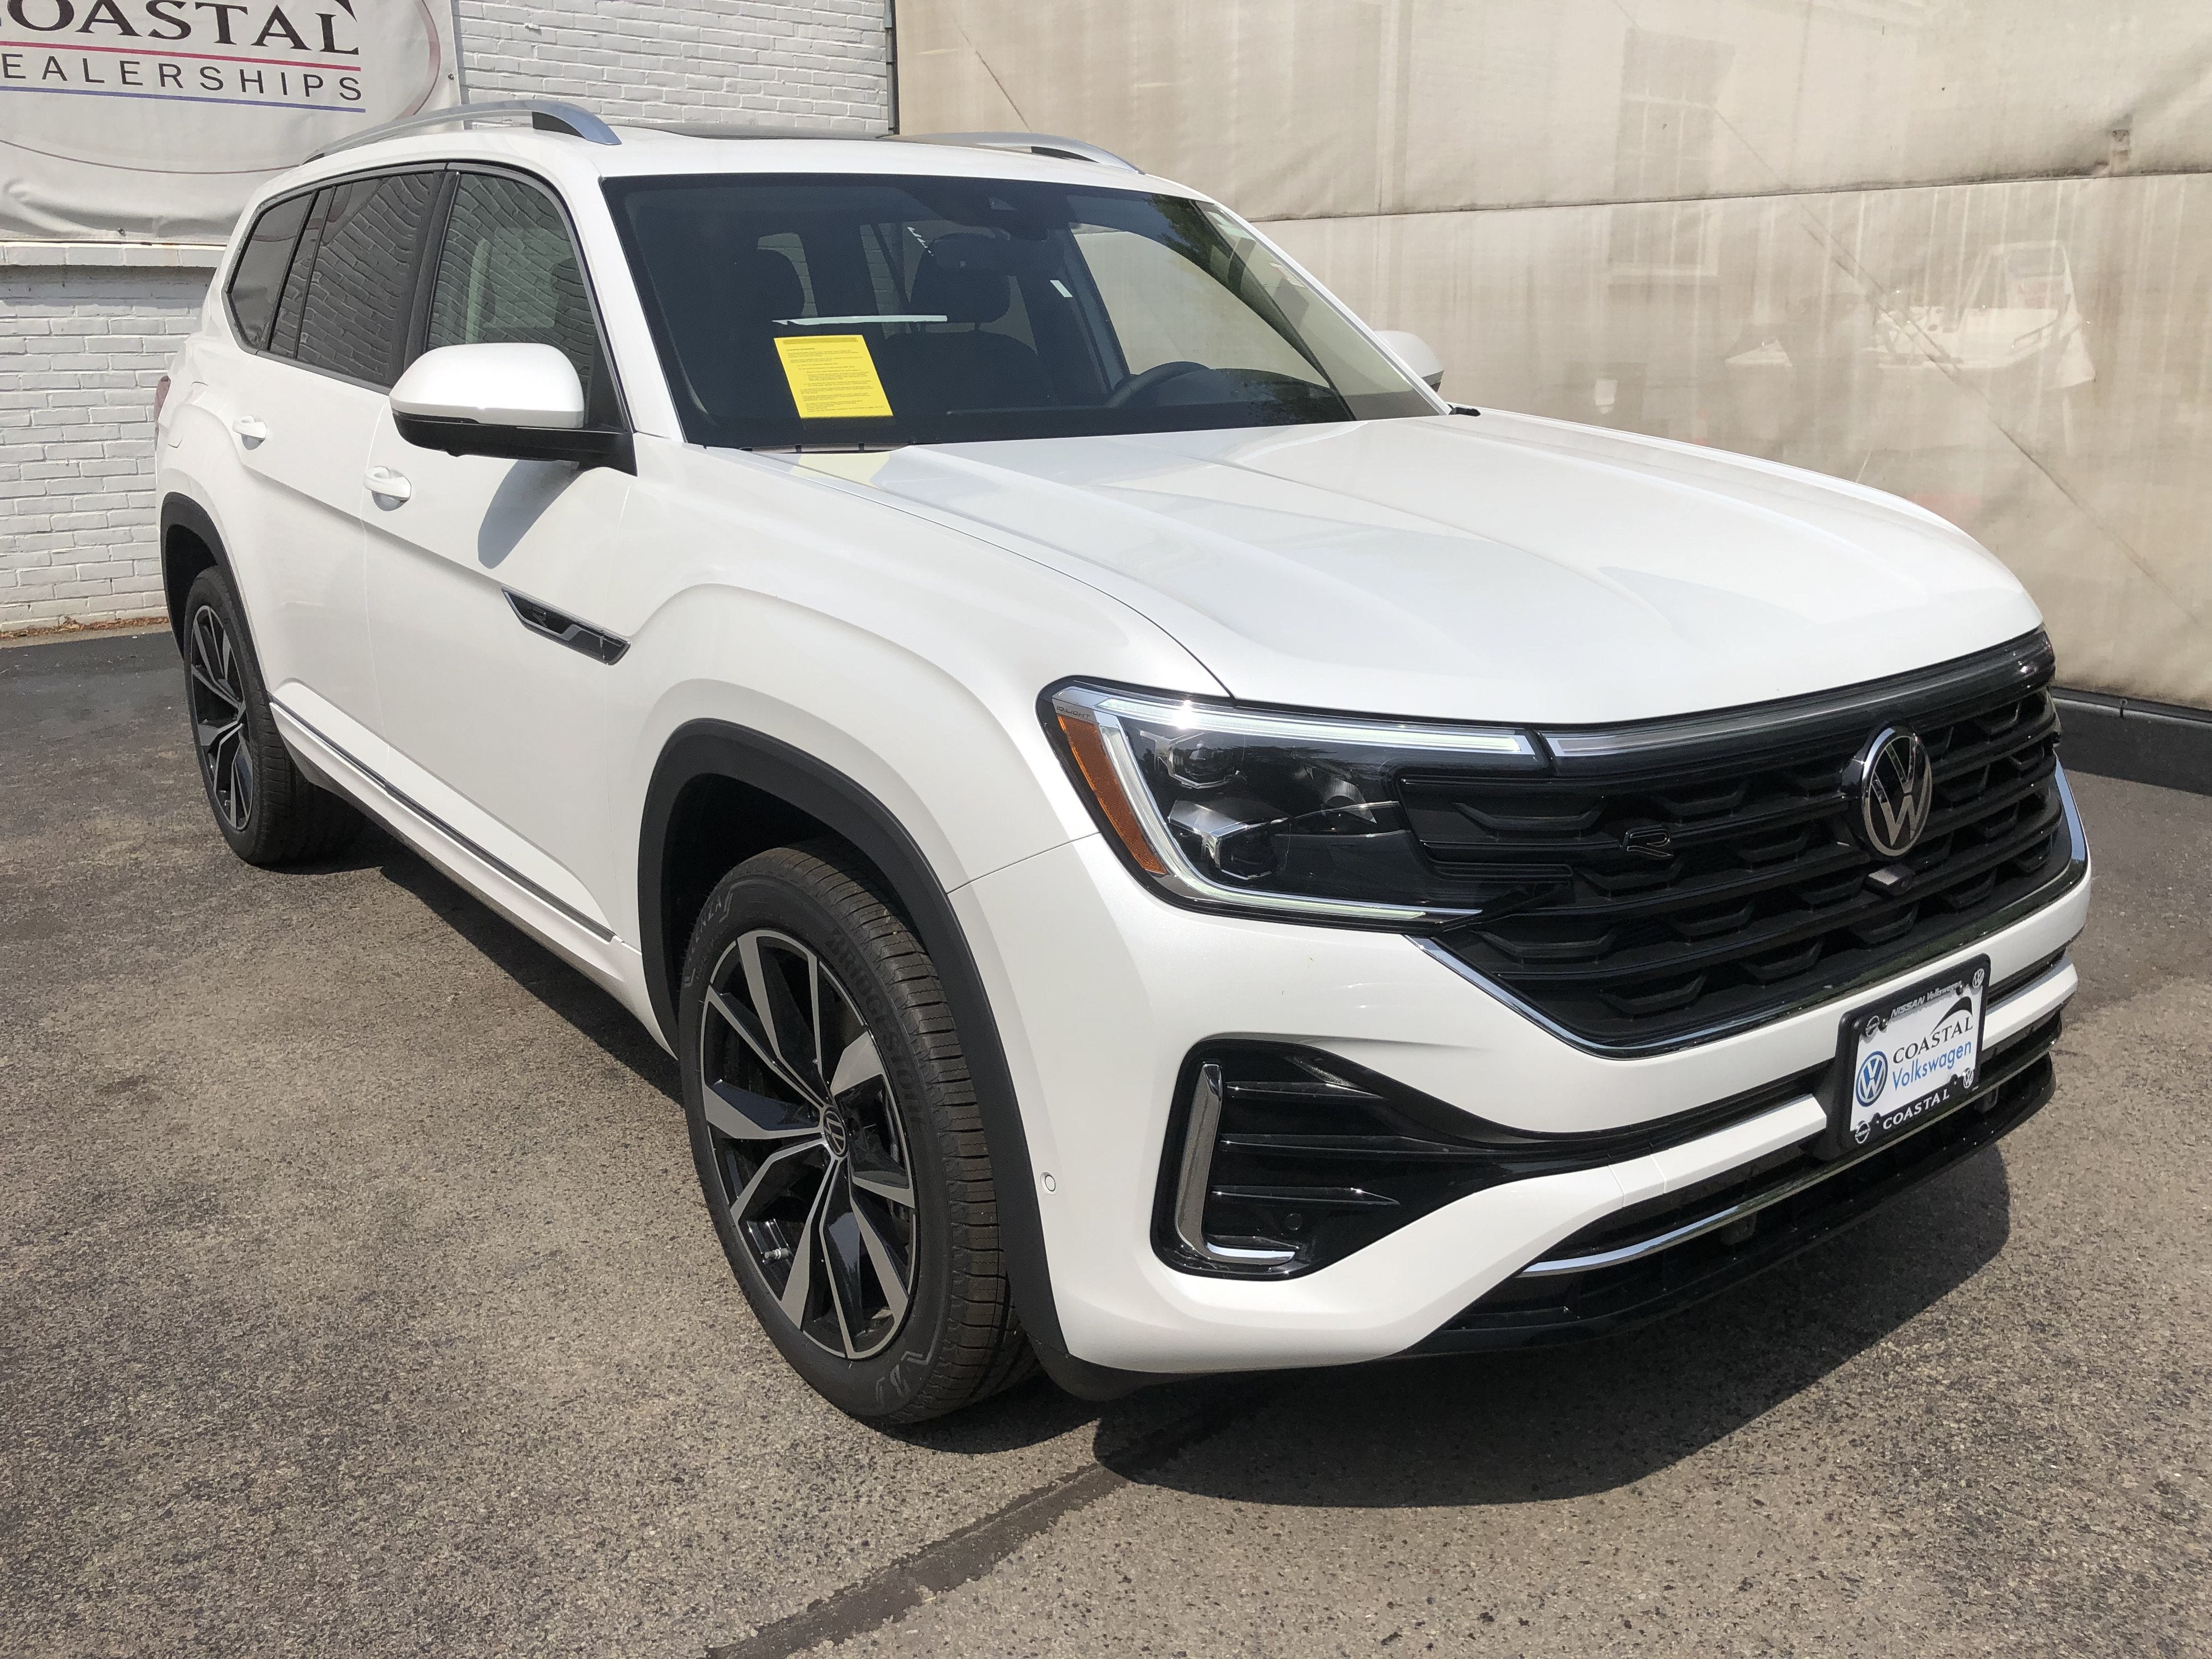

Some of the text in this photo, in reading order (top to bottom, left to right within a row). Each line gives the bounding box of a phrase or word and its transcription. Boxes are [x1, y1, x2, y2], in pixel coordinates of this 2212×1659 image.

[0, 0, 359, 55] OASTAL
[1, 53, 362, 100] EALERSHIPS
[1891, 995, 1925, 1018] NISSAN
[1893, 1017, 1973, 1064] COASTAL
[1892, 1041, 1972, 1091] Volkswagen
[1882, 1089, 1950, 1130] COASTAL
